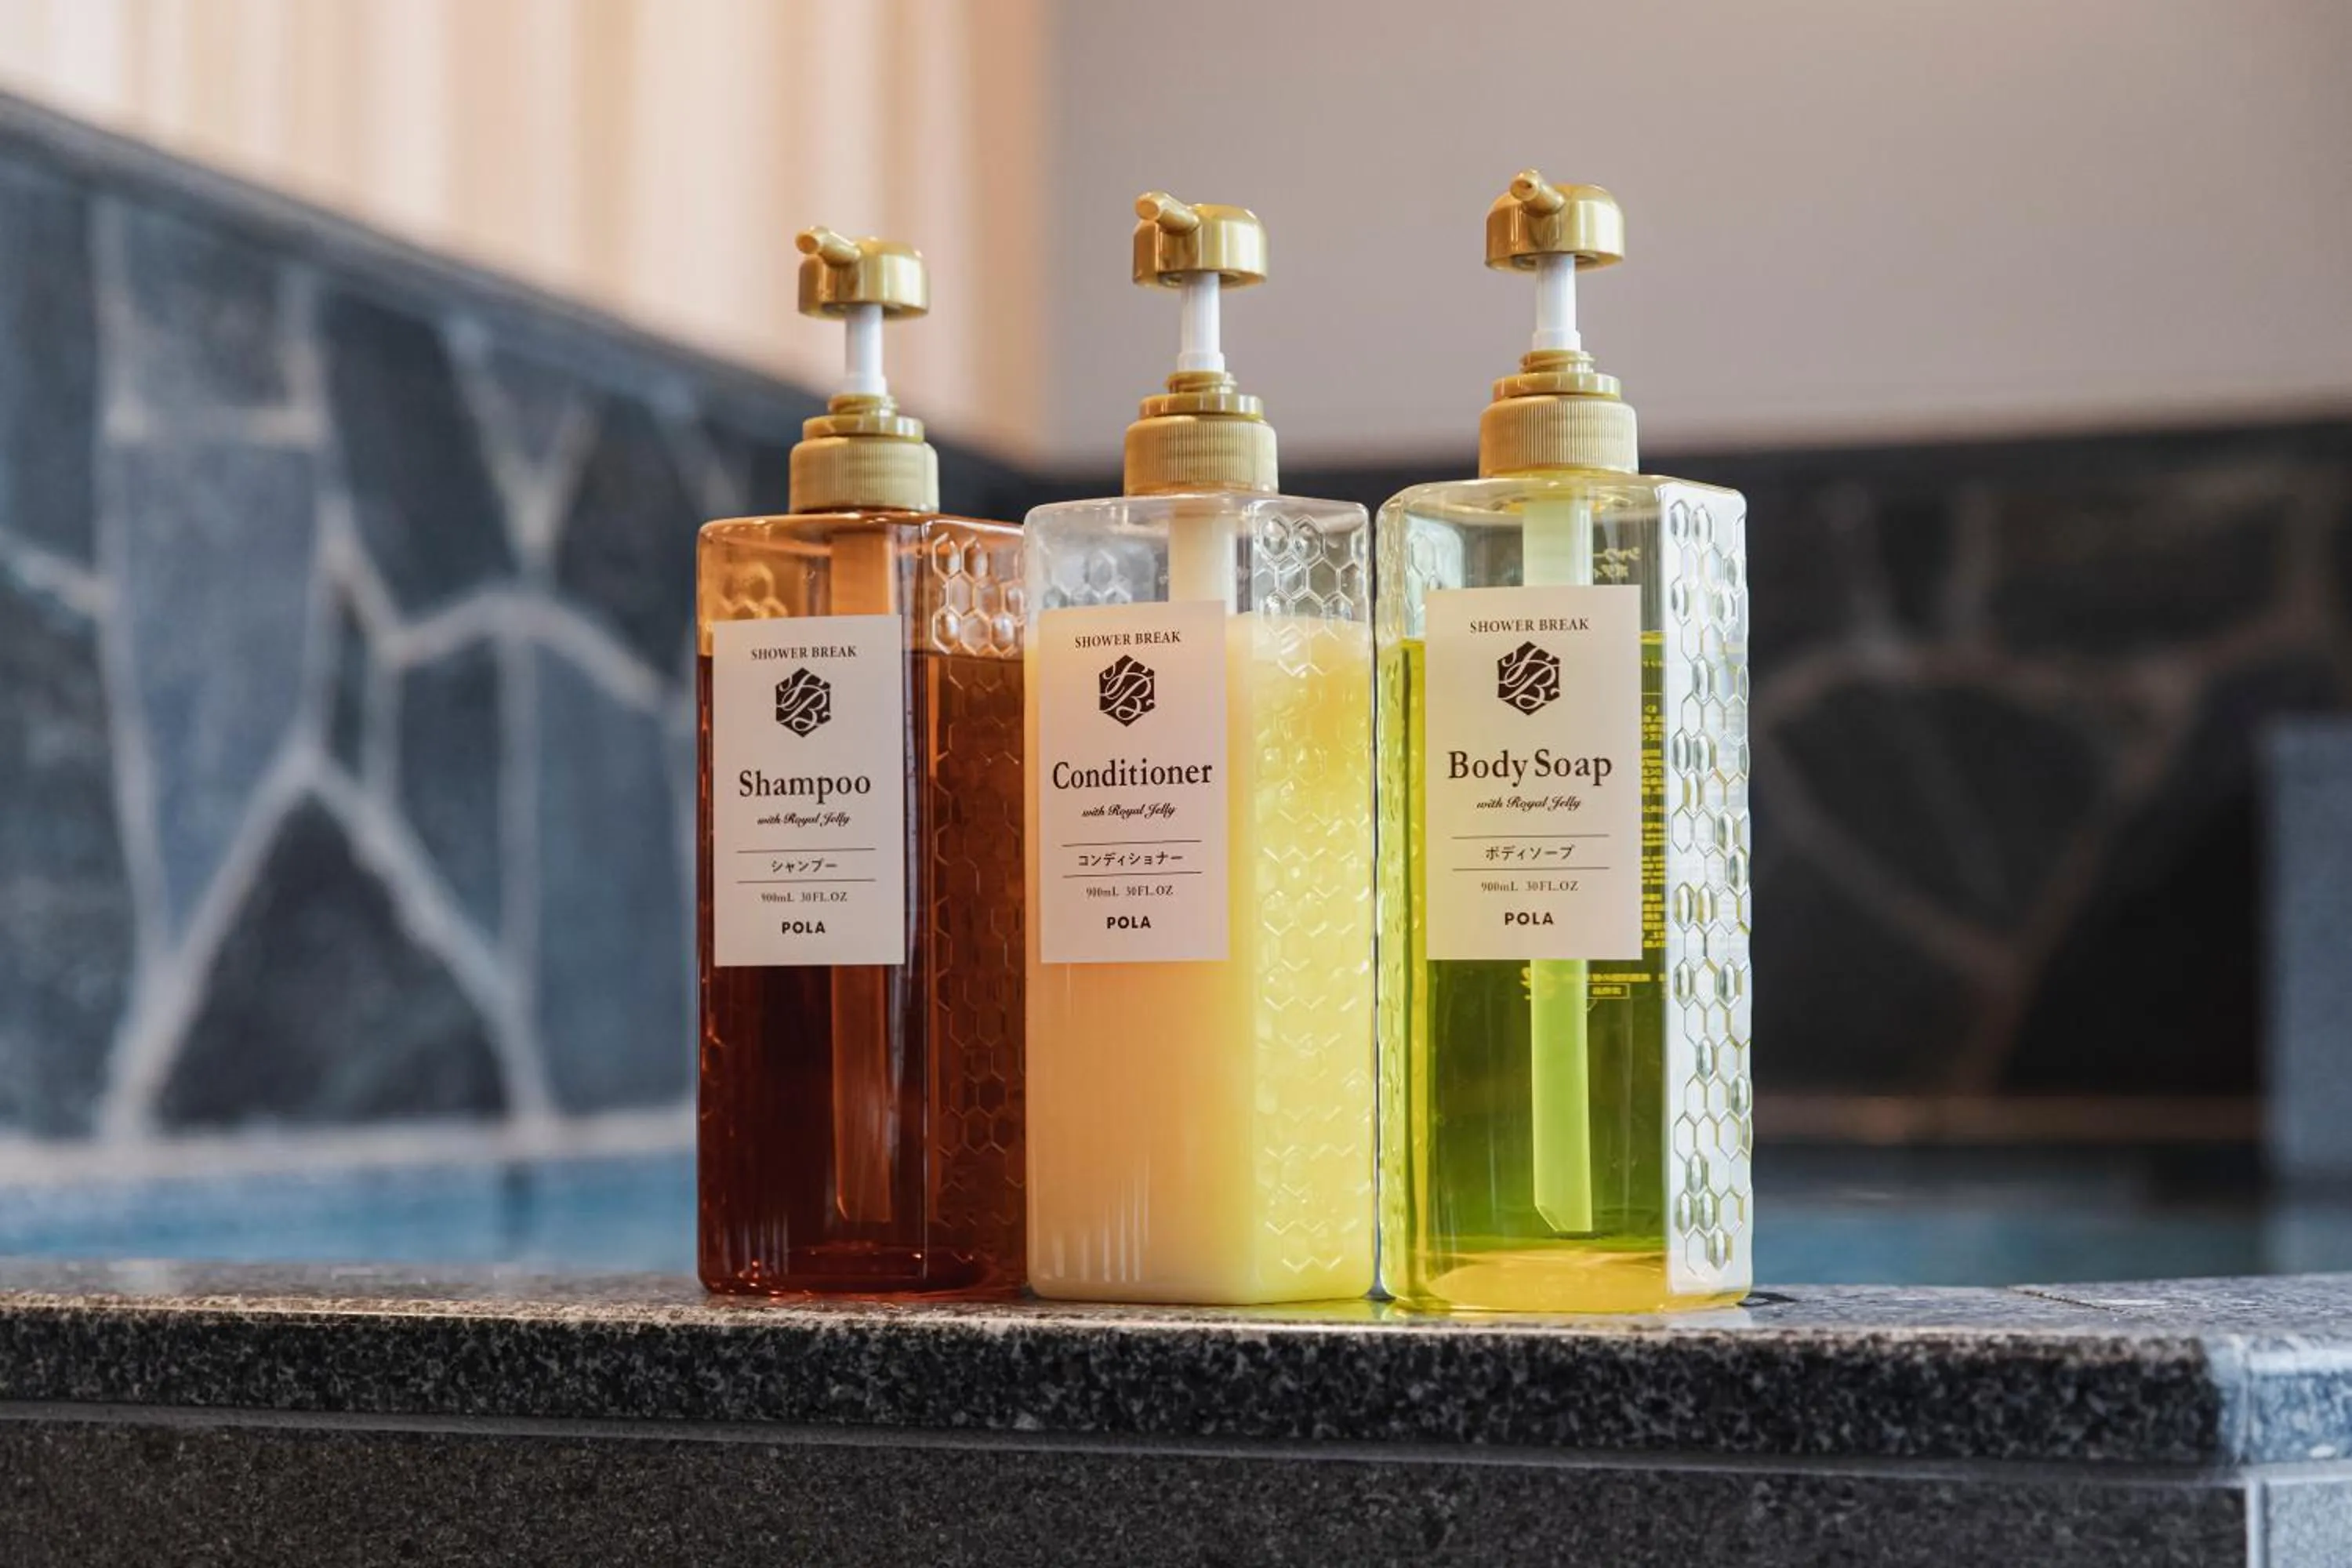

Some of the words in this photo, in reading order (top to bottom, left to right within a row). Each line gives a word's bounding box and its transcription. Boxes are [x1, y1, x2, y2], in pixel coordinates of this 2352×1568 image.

[1470, 619, 1535, 633] SHOWER
[1539, 618, 1589, 631] BREAK
[1075, 633, 1131, 648] SHOWER
[1135, 631, 1181, 645] BREAK
[751, 647, 808, 660] SHOWER
[811, 645, 856, 658] BREAK
[1052, 757, 1213, 789] Conditioner
[1448, 750, 1528, 788] Body
[1534, 748, 1613, 786] Soap
[739, 769, 871, 805] Shampoo
[1081, 805, 1105, 817] with
[1107, 804, 1145, 820] Royal
[1143, 802, 1175, 818] Jelly
[1476, 797, 1503, 808] with
[1506, 796, 1548, 812] Royal
[1547, 796, 1581, 811] Jelly
[757, 813, 782, 825] with
[783, 812, 821, 828] Royal
[819, 811, 850, 827] Jelly
[1078, 851, 1183, 867] コンディショナー
[1485, 843, 1577, 862] ボディソープ
[771, 857, 839, 873] シャンプー
[1106, 915, 1152, 929] POLA
[1504, 912, 1554, 926] POLA
[782, 920, 826, 935] POLA
